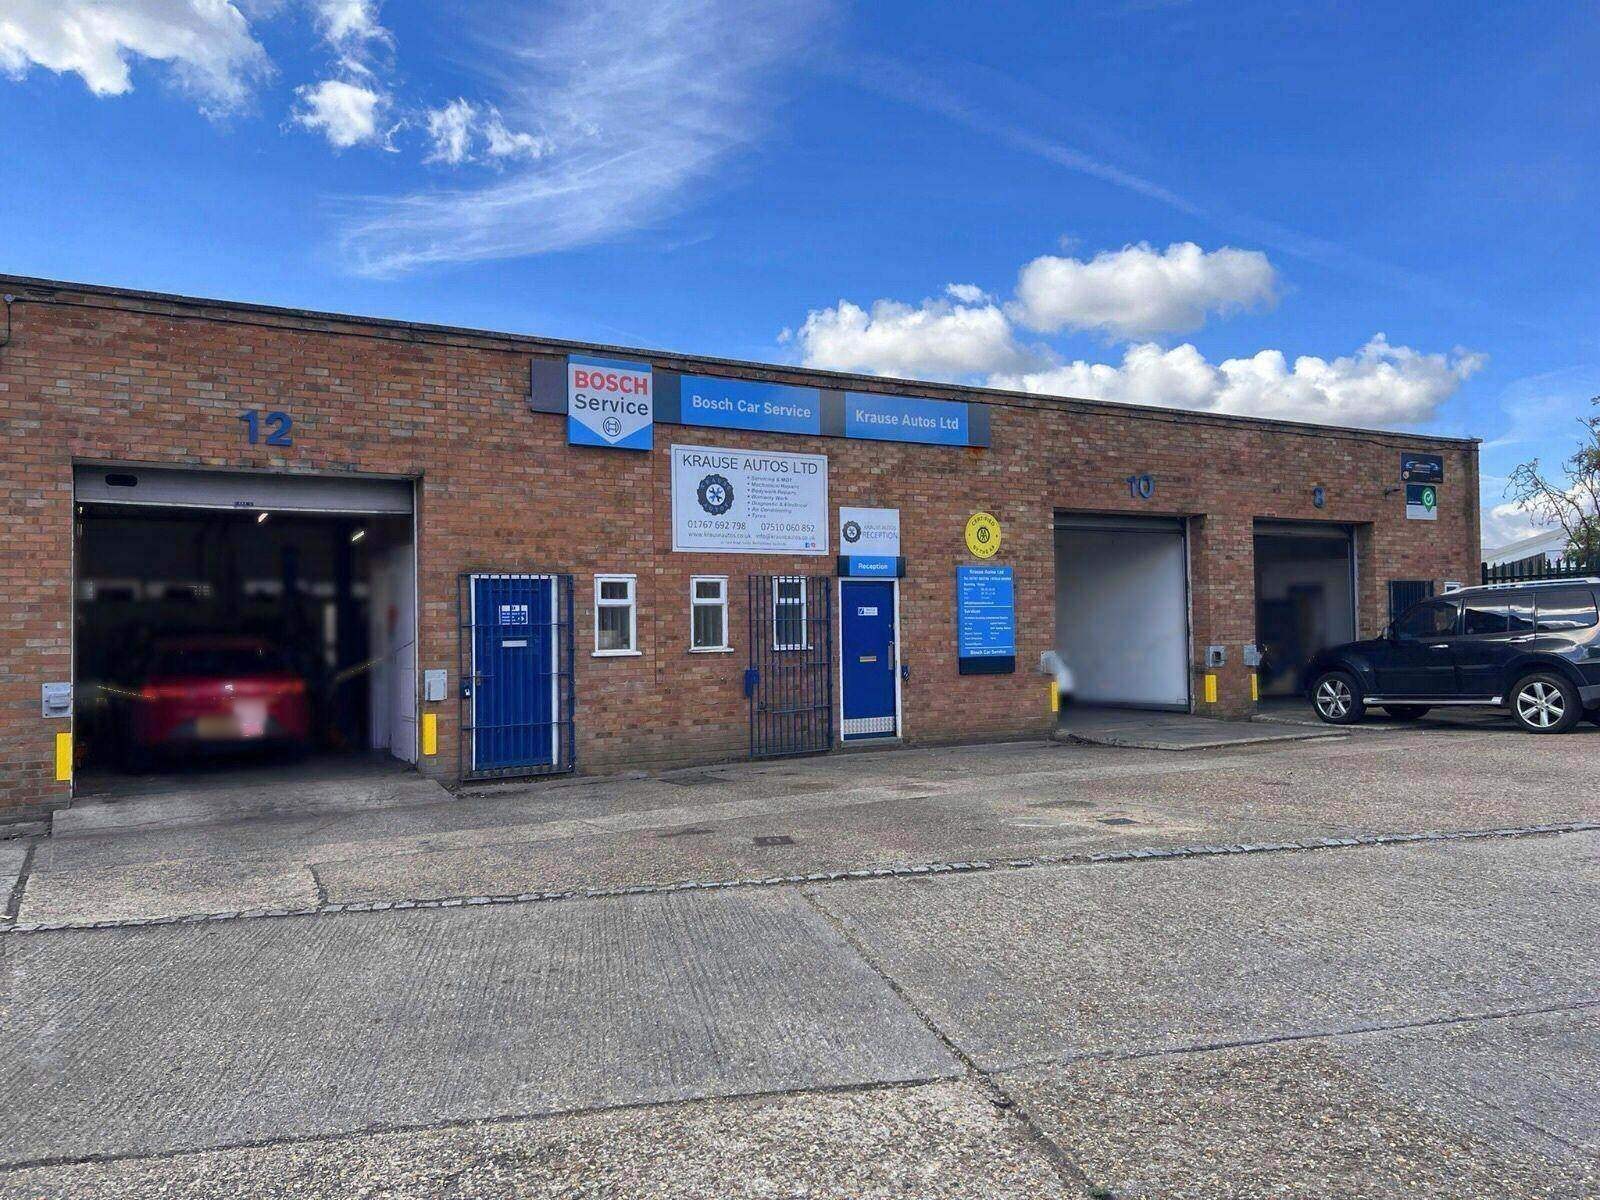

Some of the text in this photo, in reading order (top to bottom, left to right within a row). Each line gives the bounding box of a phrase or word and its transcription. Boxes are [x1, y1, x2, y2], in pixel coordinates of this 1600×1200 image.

[575, 371, 648, 395] BOSCH
[575, 393, 648, 415] Service
[692, 395, 811, 418] Bosch Car Service
[240, 409, 293, 446] 12
[855, 409, 959, 430] Krause Autos Ltd
[682, 454, 818, 475] KRAUSE AUTOS LTD
[1126, 472, 1155, 499] 10
[1312, 486, 1326, 508] 8
[687, 520, 746, 531] 01767 692 798
[760, 522, 815, 533] 07510 060 852
[862, 530, 898, 539] RECEPTION
[858, 562, 888, 570] Reception
